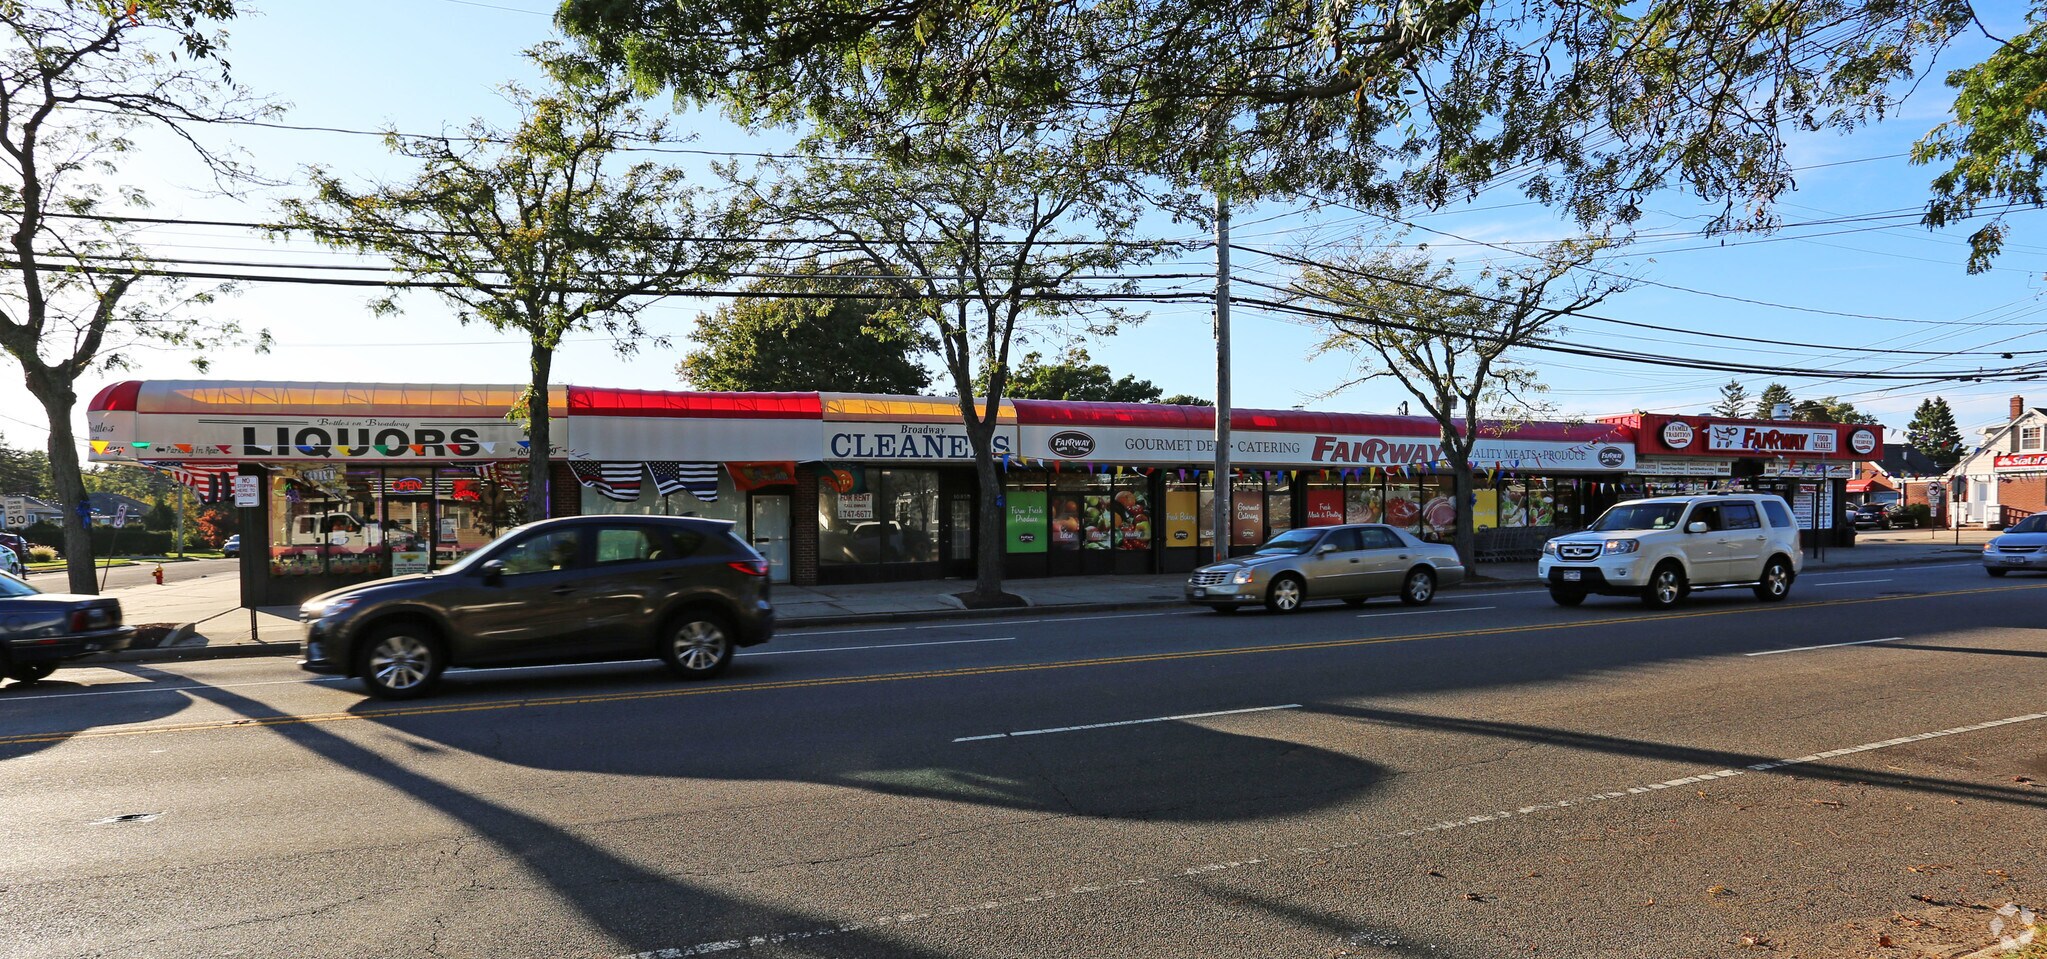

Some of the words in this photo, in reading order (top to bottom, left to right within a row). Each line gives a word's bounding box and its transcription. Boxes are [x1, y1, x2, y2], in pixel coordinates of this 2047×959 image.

[317, 418, 350, 426] Bottles
[365, 419, 410, 429] Broadway
[900, 425, 946, 435] Broadway
[243, 427, 480, 458] LIQUORS
[1055, 437, 1091, 449] FAIRWAY
[1125, 438, 1193, 451] GOURMET
[1742, 428, 1808, 450] FAIRWAY
[831, 433, 1011, 458] CLEANES
[1237, 441, 1300, 453] CATERING
[1311, 435, 1443, 463] FAIRWAY
[1468, 448, 1502, 458] UALITY
[1505, 449, 1538, 459] MEATS
[1541, 451, 1586, 461] PRODUCE
[392, 480, 422, 491] OPEN
[1237, 503, 1260, 511] Gourmet
[8, 516, 25, 525] 30
[1015, 515, 1038, 523] Produce
[1237, 512, 1259, 523] Catering
